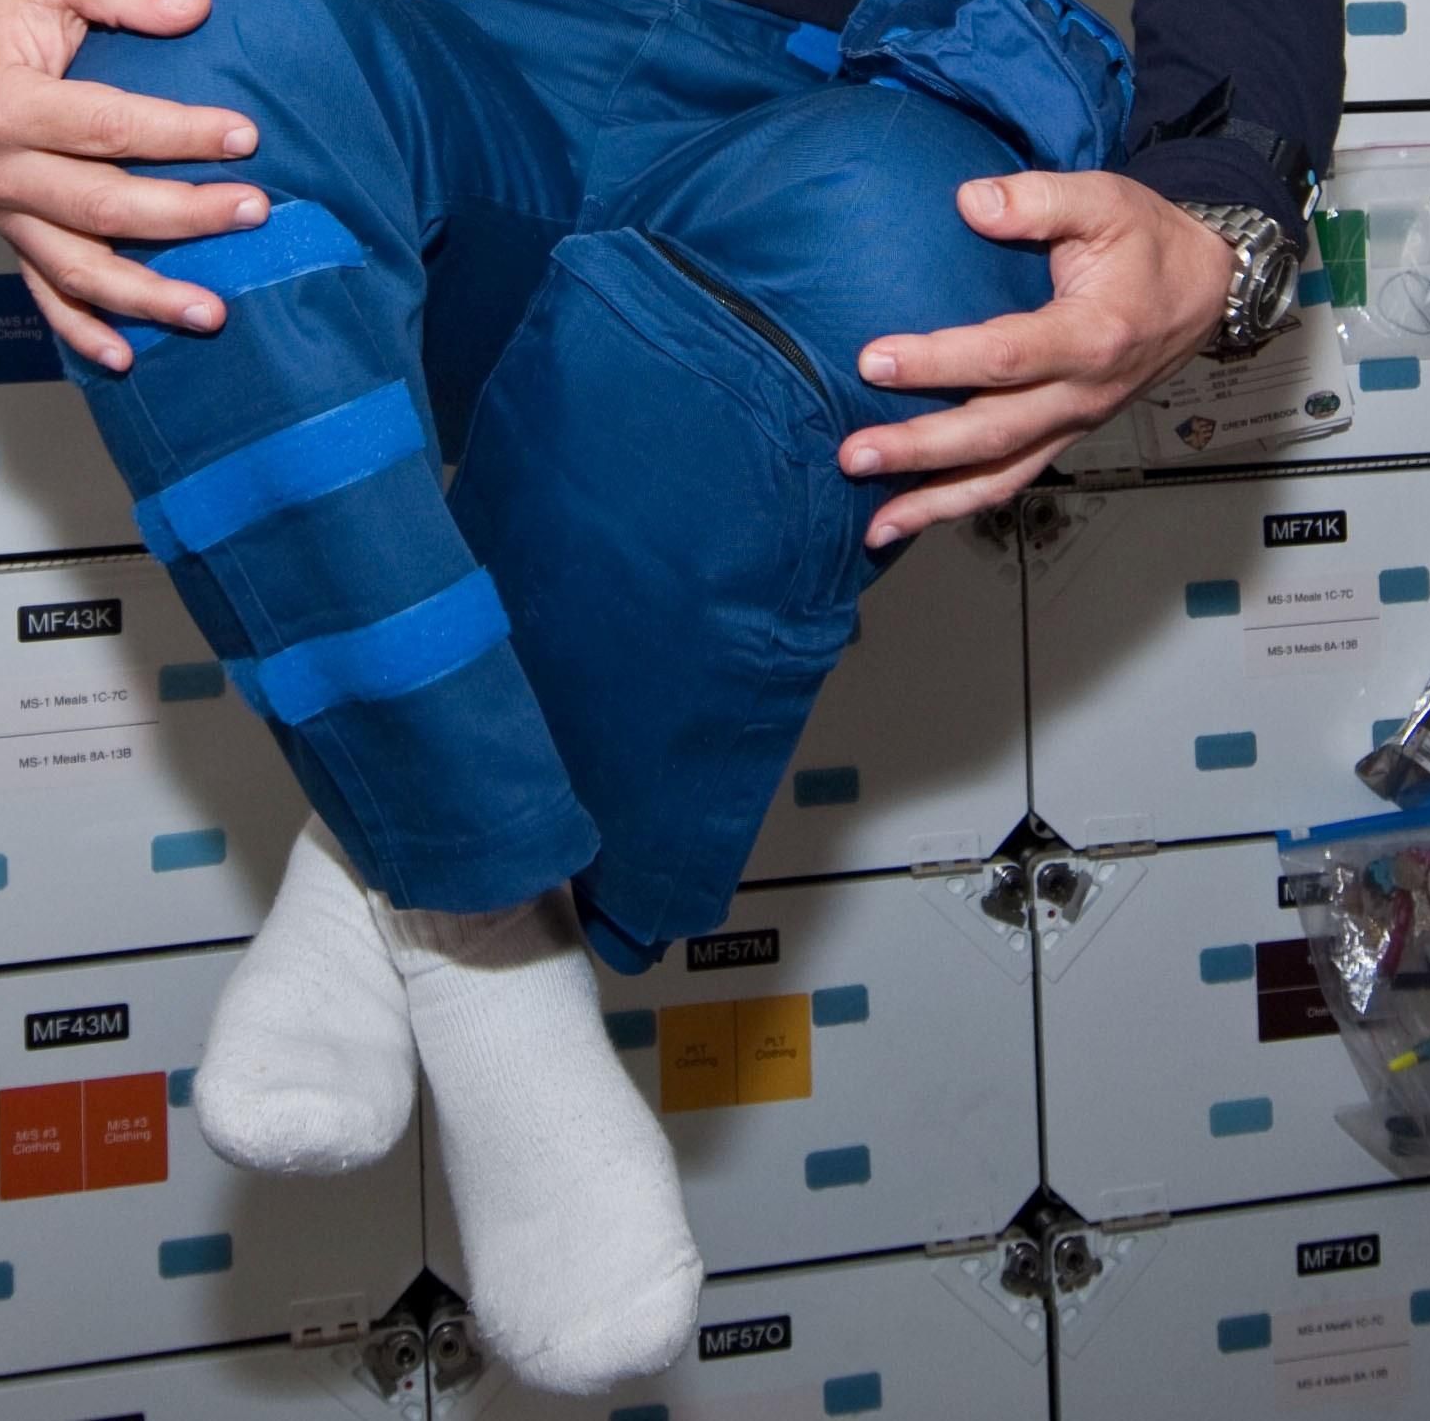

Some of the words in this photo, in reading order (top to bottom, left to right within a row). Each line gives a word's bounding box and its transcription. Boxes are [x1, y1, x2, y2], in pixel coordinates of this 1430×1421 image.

[1250, 407, 1299, 426] NOTEBOOK
[1272, 517, 1340, 541] MF71K
[1267, 594, 1292, 606] MS-3
[1294, 592, 1322, 603] Meals
[1324, 588, 1354, 601] 1C-7C
[27, 606, 114, 635] MF43K
[1267, 646, 1293, 657] MS-3
[1294, 644, 1322, 654] Meals
[20, 697, 50, 710] MS-1
[54, 693, 88, 708] Meals
[92, 689, 129, 704] 1C-7C
[18, 756, 49, 770] MS-1
[52, 752, 87, 766] Meals
[90, 747, 132, 762] 8A-13B
[693, 938, 773, 965] MF57M
[32, 1011, 122, 1043] MF43M
[675, 1056, 719, 1070] Clothing
[755, 1048, 798, 1062] Clothing
[106, 1119, 131, 1132] M/S
[133, 1116, 149, 1129] #3
[15, 1128, 40, 1142] M/S
[42, 1127, 58, 1139] #3
[104, 1130, 152, 1145] Clothing
[12, 1140, 62, 1156] Clothing
